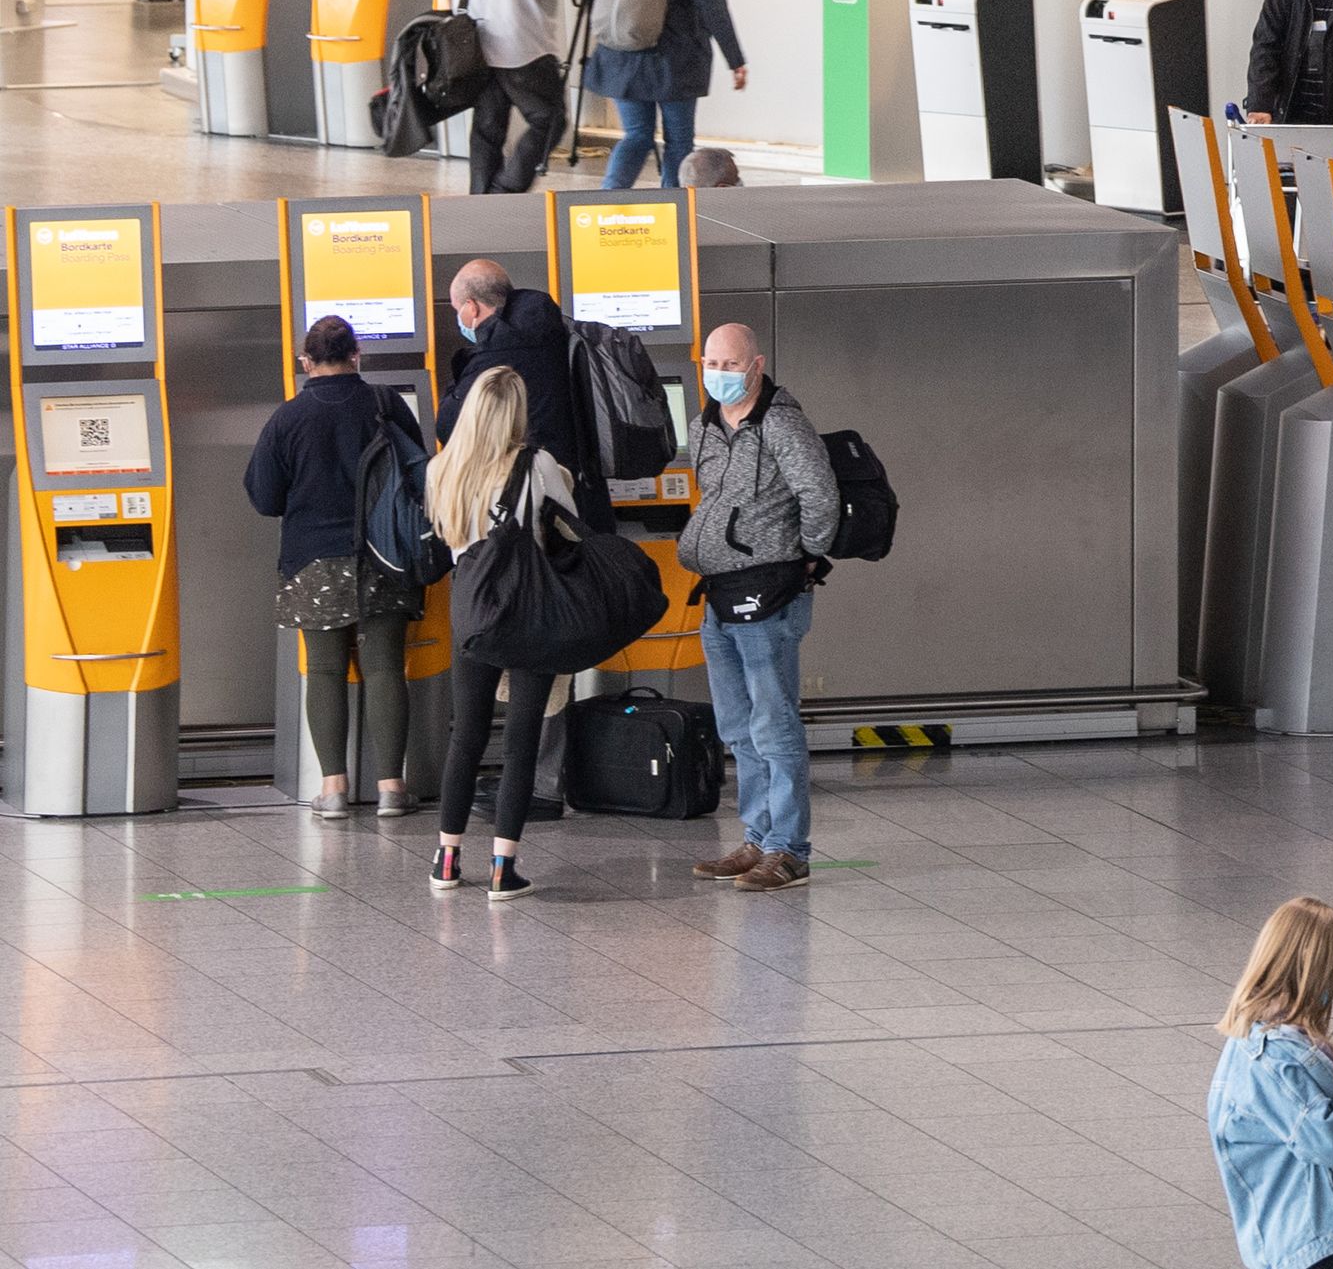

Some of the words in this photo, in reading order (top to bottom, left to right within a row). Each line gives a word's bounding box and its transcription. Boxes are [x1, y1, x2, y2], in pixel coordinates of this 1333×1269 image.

[599, 226, 650, 236] Bordkarte
[332, 233, 384, 243] Bordkarte
[599, 237, 642, 247] Boarding
[60, 242, 113, 252] Bordkarte
[332, 244, 377, 255] Boarding
[60, 253, 105, 263] Boarding
